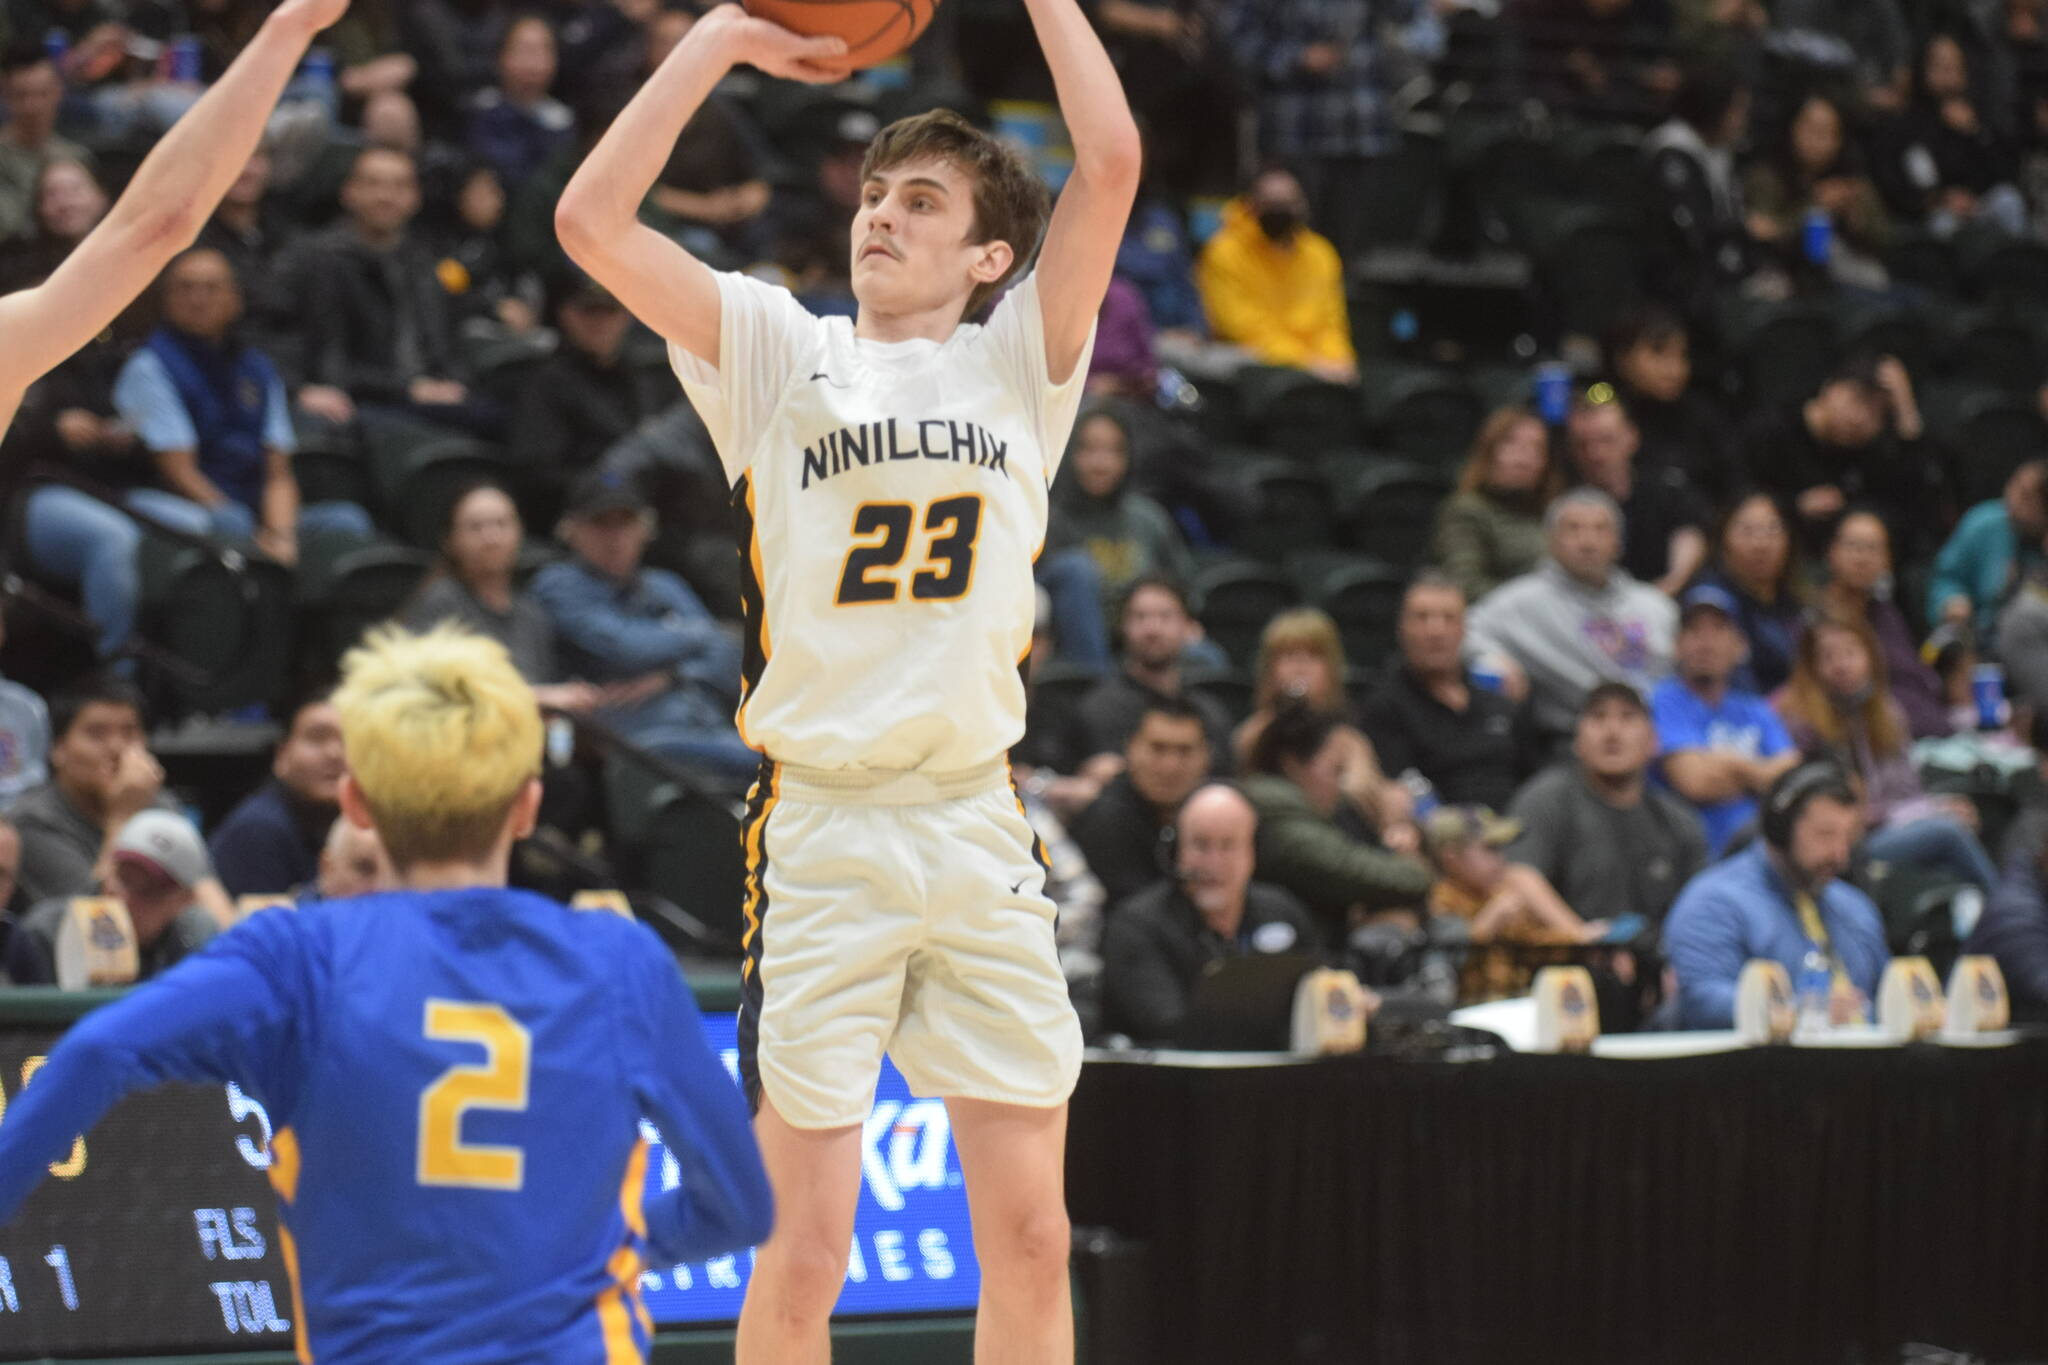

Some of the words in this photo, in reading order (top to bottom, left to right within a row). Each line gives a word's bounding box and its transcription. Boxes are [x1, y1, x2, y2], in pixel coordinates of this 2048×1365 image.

[802, 417, 1010, 490] NINILCHIK
[833, 492, 985, 607] 23
[416, 998, 532, 1191] 2
[193, 1207, 267, 1261] FLS
[43, 1243, 80, 1311] 1
[208, 1280, 291, 1334] TOL
